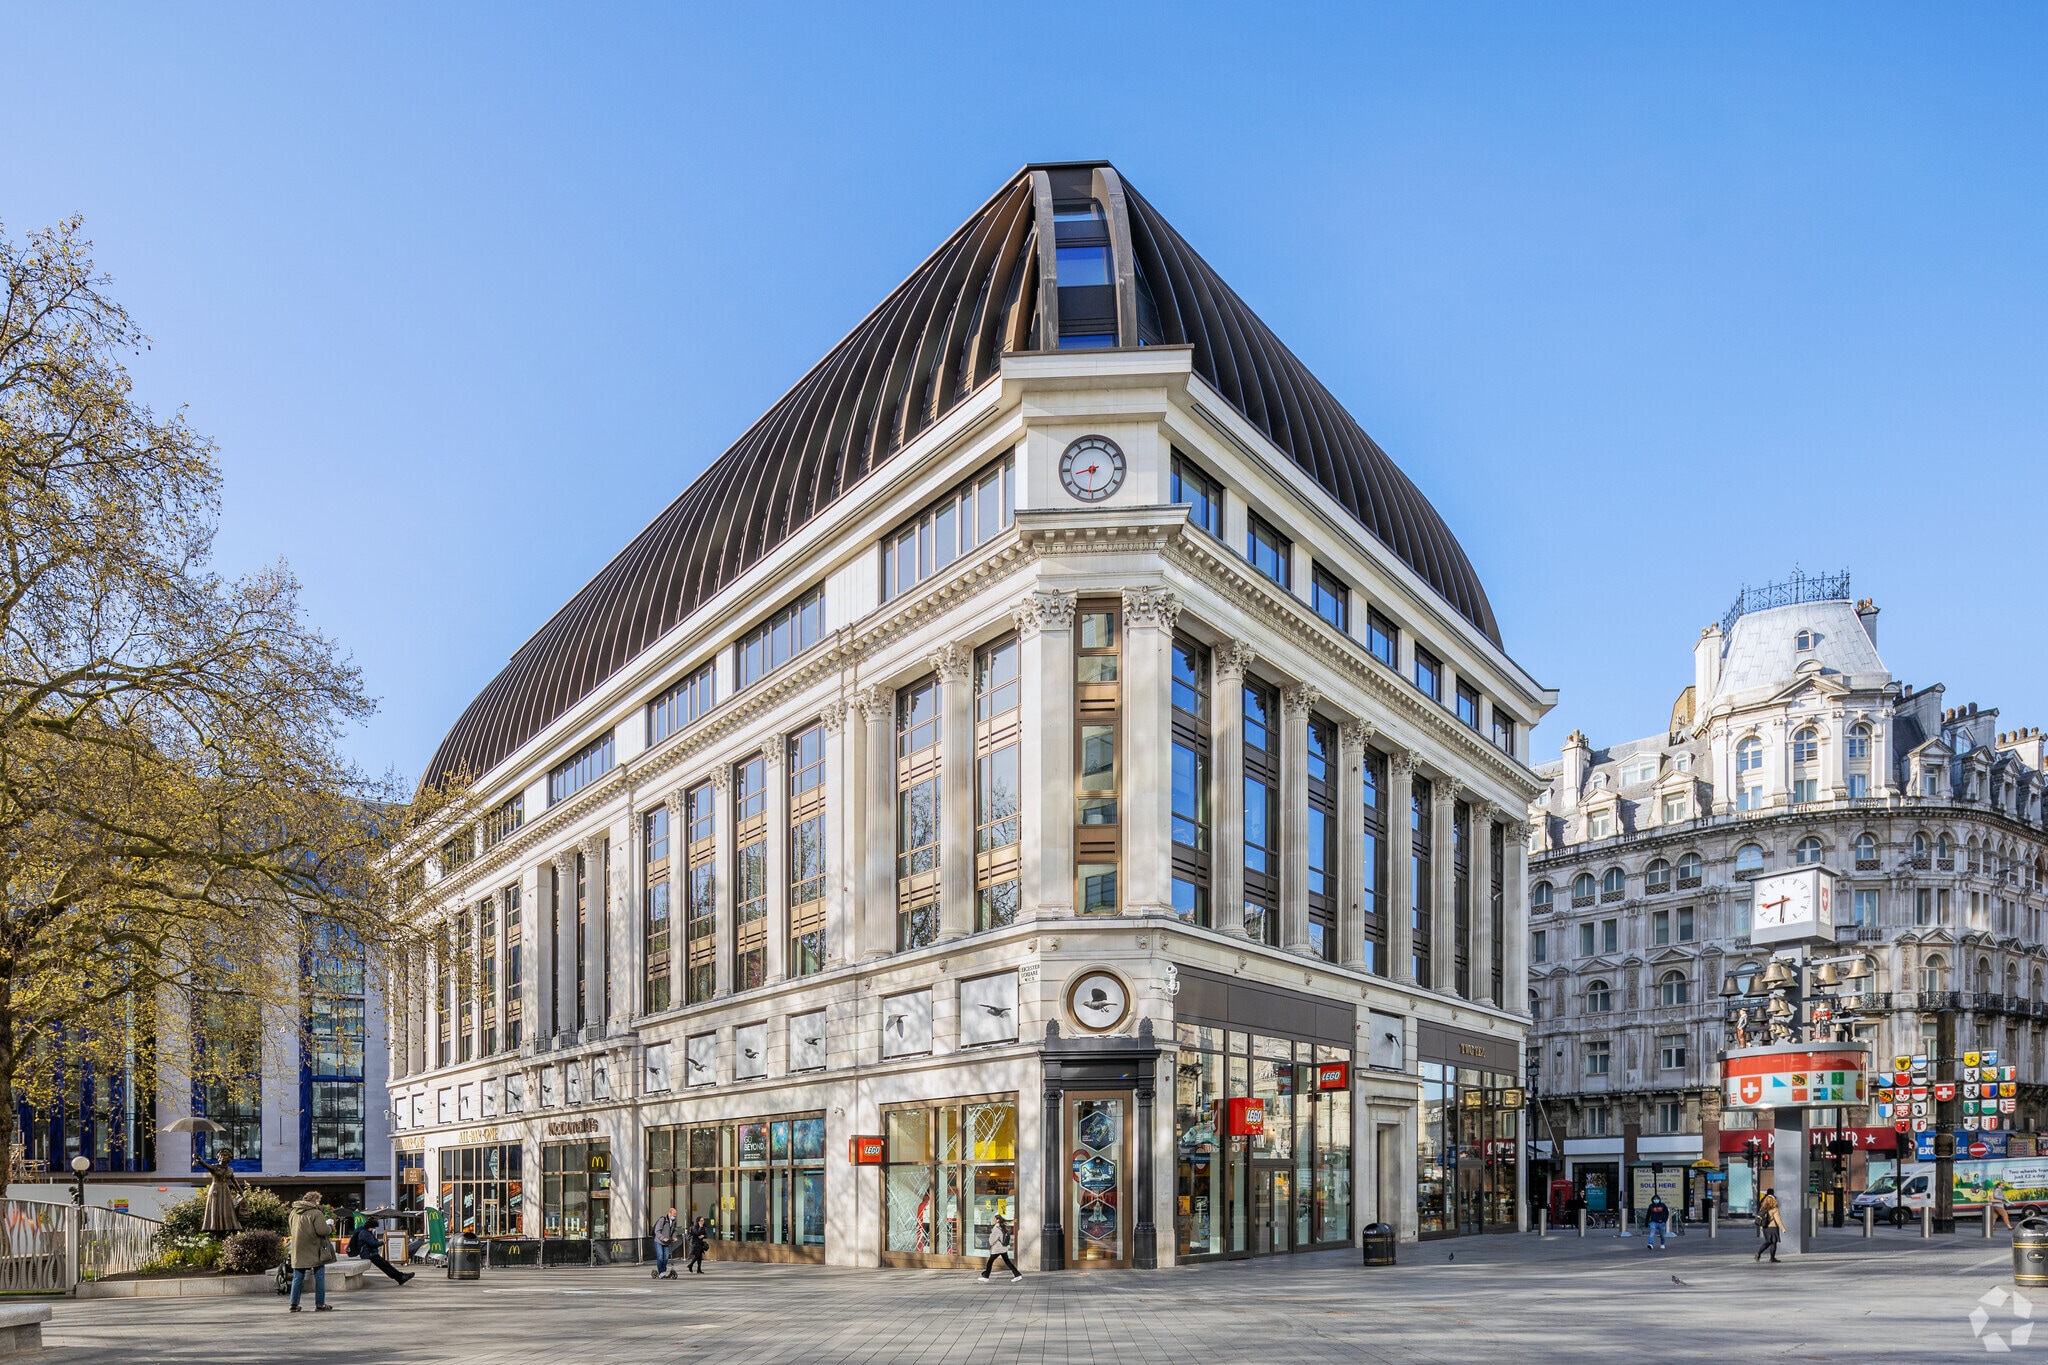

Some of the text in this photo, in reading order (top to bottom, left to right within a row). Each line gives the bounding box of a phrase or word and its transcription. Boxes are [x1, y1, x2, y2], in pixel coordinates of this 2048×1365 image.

[1322, 1072, 1340, 1081] LEGO
[1246, 1109, 1262, 1123] LEGO
[548, 1117, 599, 1136] McDonald's
[1813, 1131, 1858, 1147] MNER
[744, 1143, 765, 1151] BEYOND
[864, 1145, 880, 1154] LEGO
